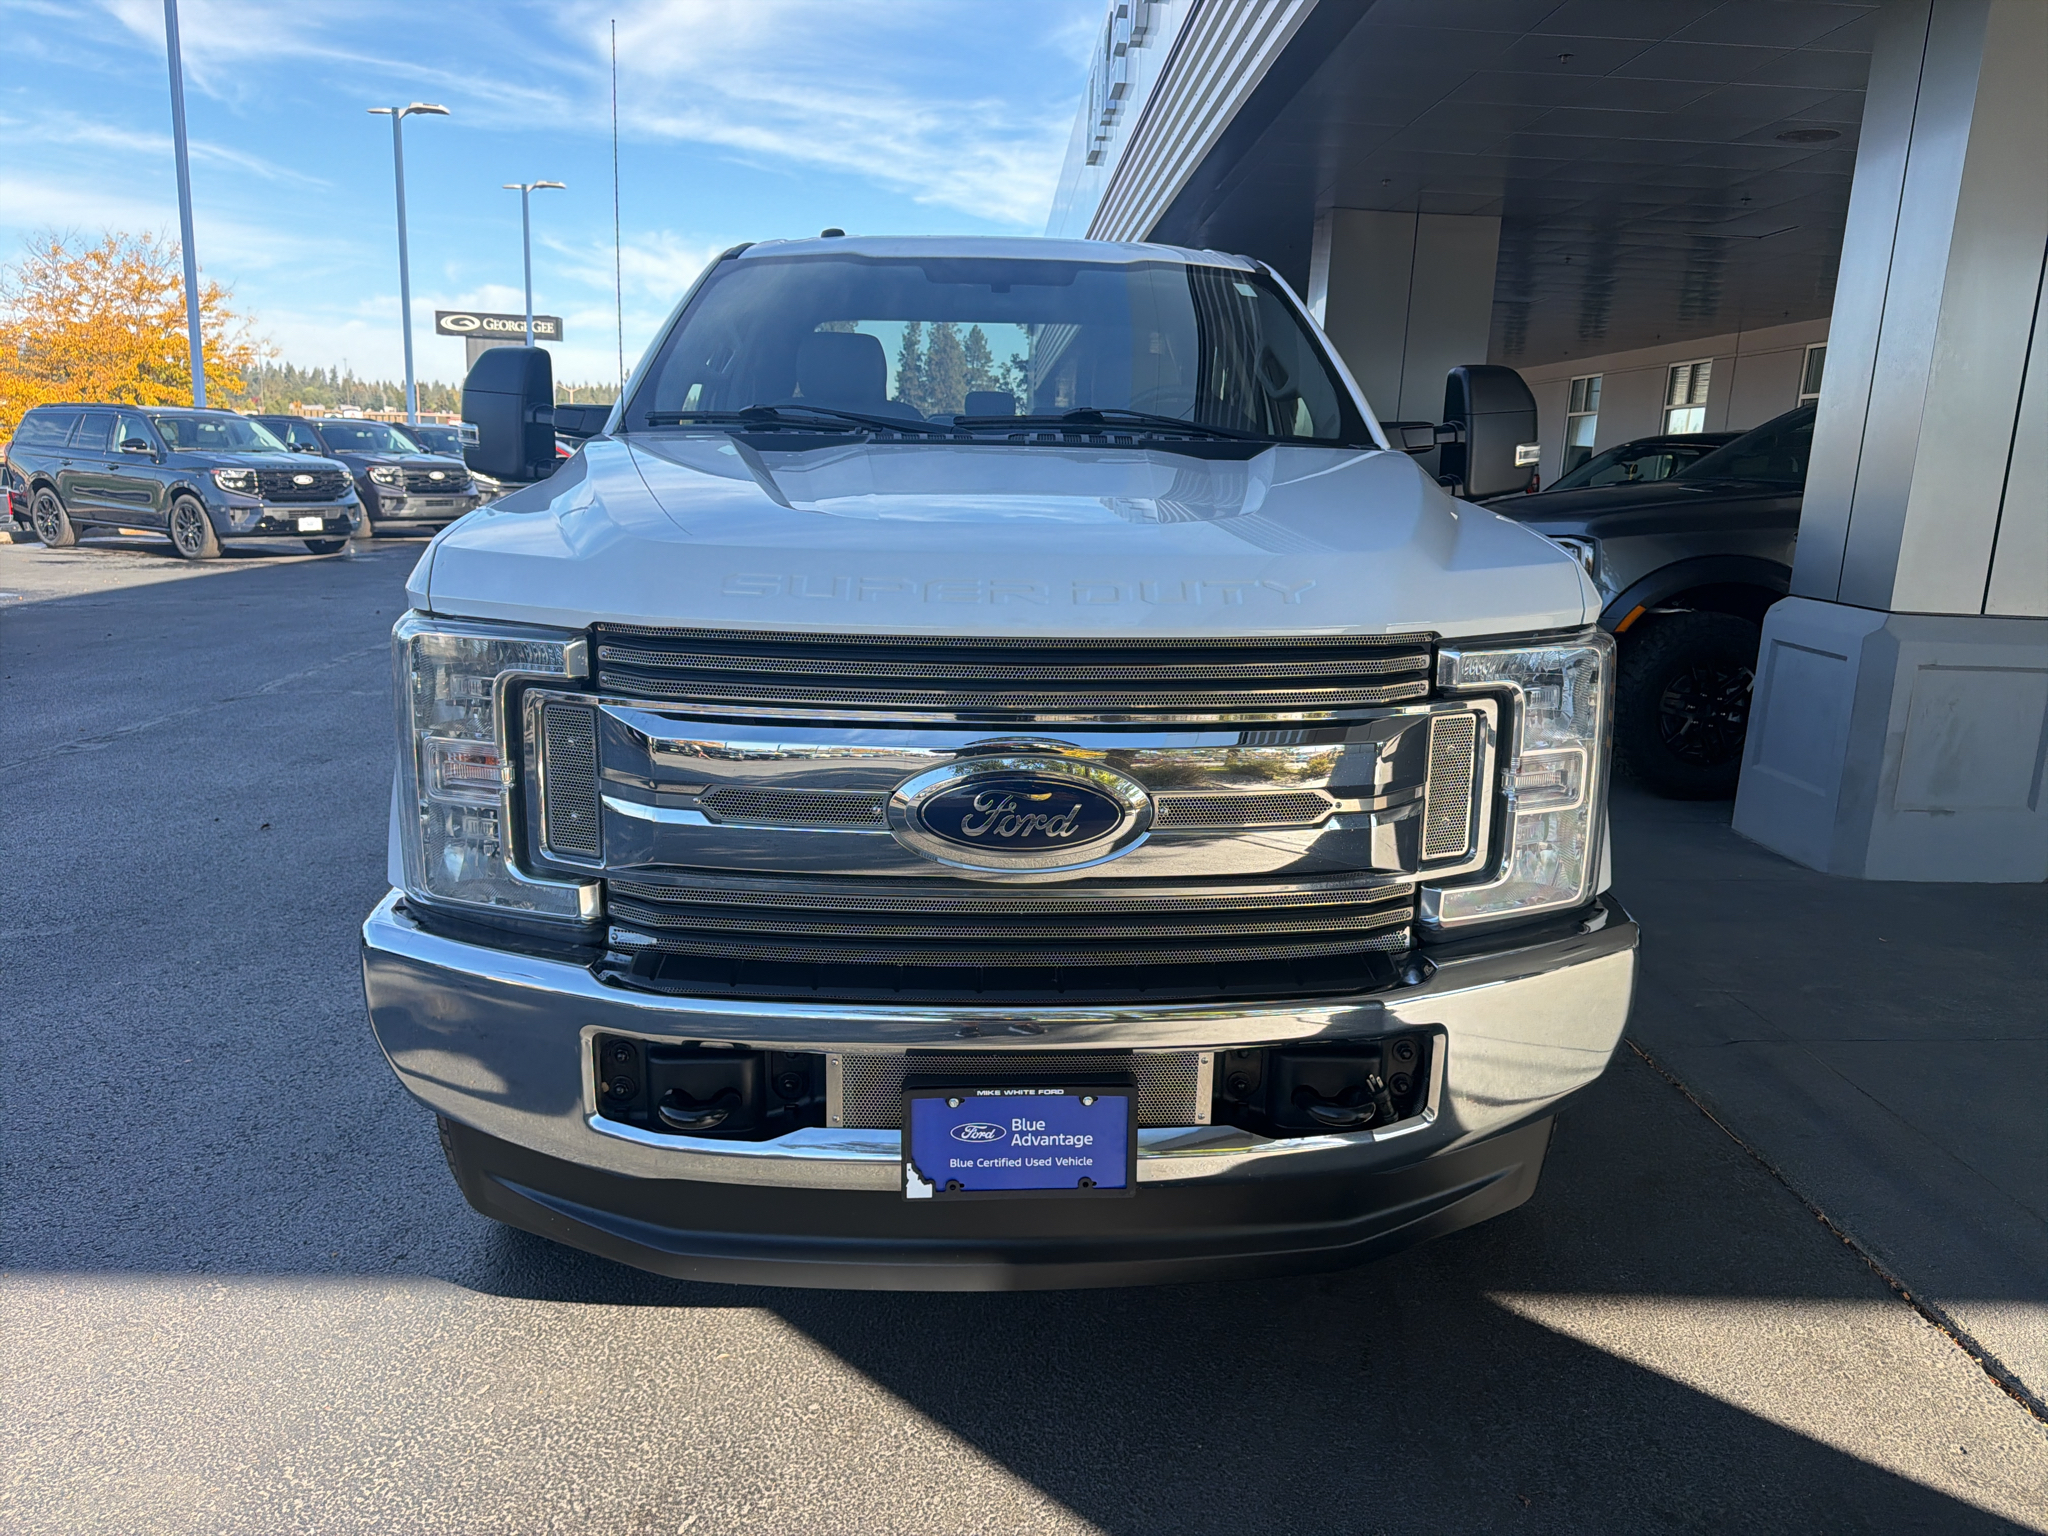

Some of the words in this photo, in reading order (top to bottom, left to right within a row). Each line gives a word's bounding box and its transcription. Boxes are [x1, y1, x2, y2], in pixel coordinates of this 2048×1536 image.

[531, 320, 555, 334] GEE
[720, 572, 1051, 606] SUPER
[1070, 578, 1319, 606] DUTY
[960, 789, 1083, 838] Ford
[1011, 1117, 1046, 1131] Blue
[960, 1125, 996, 1140] Ford
[1010, 1132, 1094, 1149] Advantage
[949, 1158, 974, 1168] Blue
[976, 1157, 1022, 1168] Certified
[1024, 1157, 1052, 1167] Used
[1054, 1156, 1093, 1166] Vehicle
